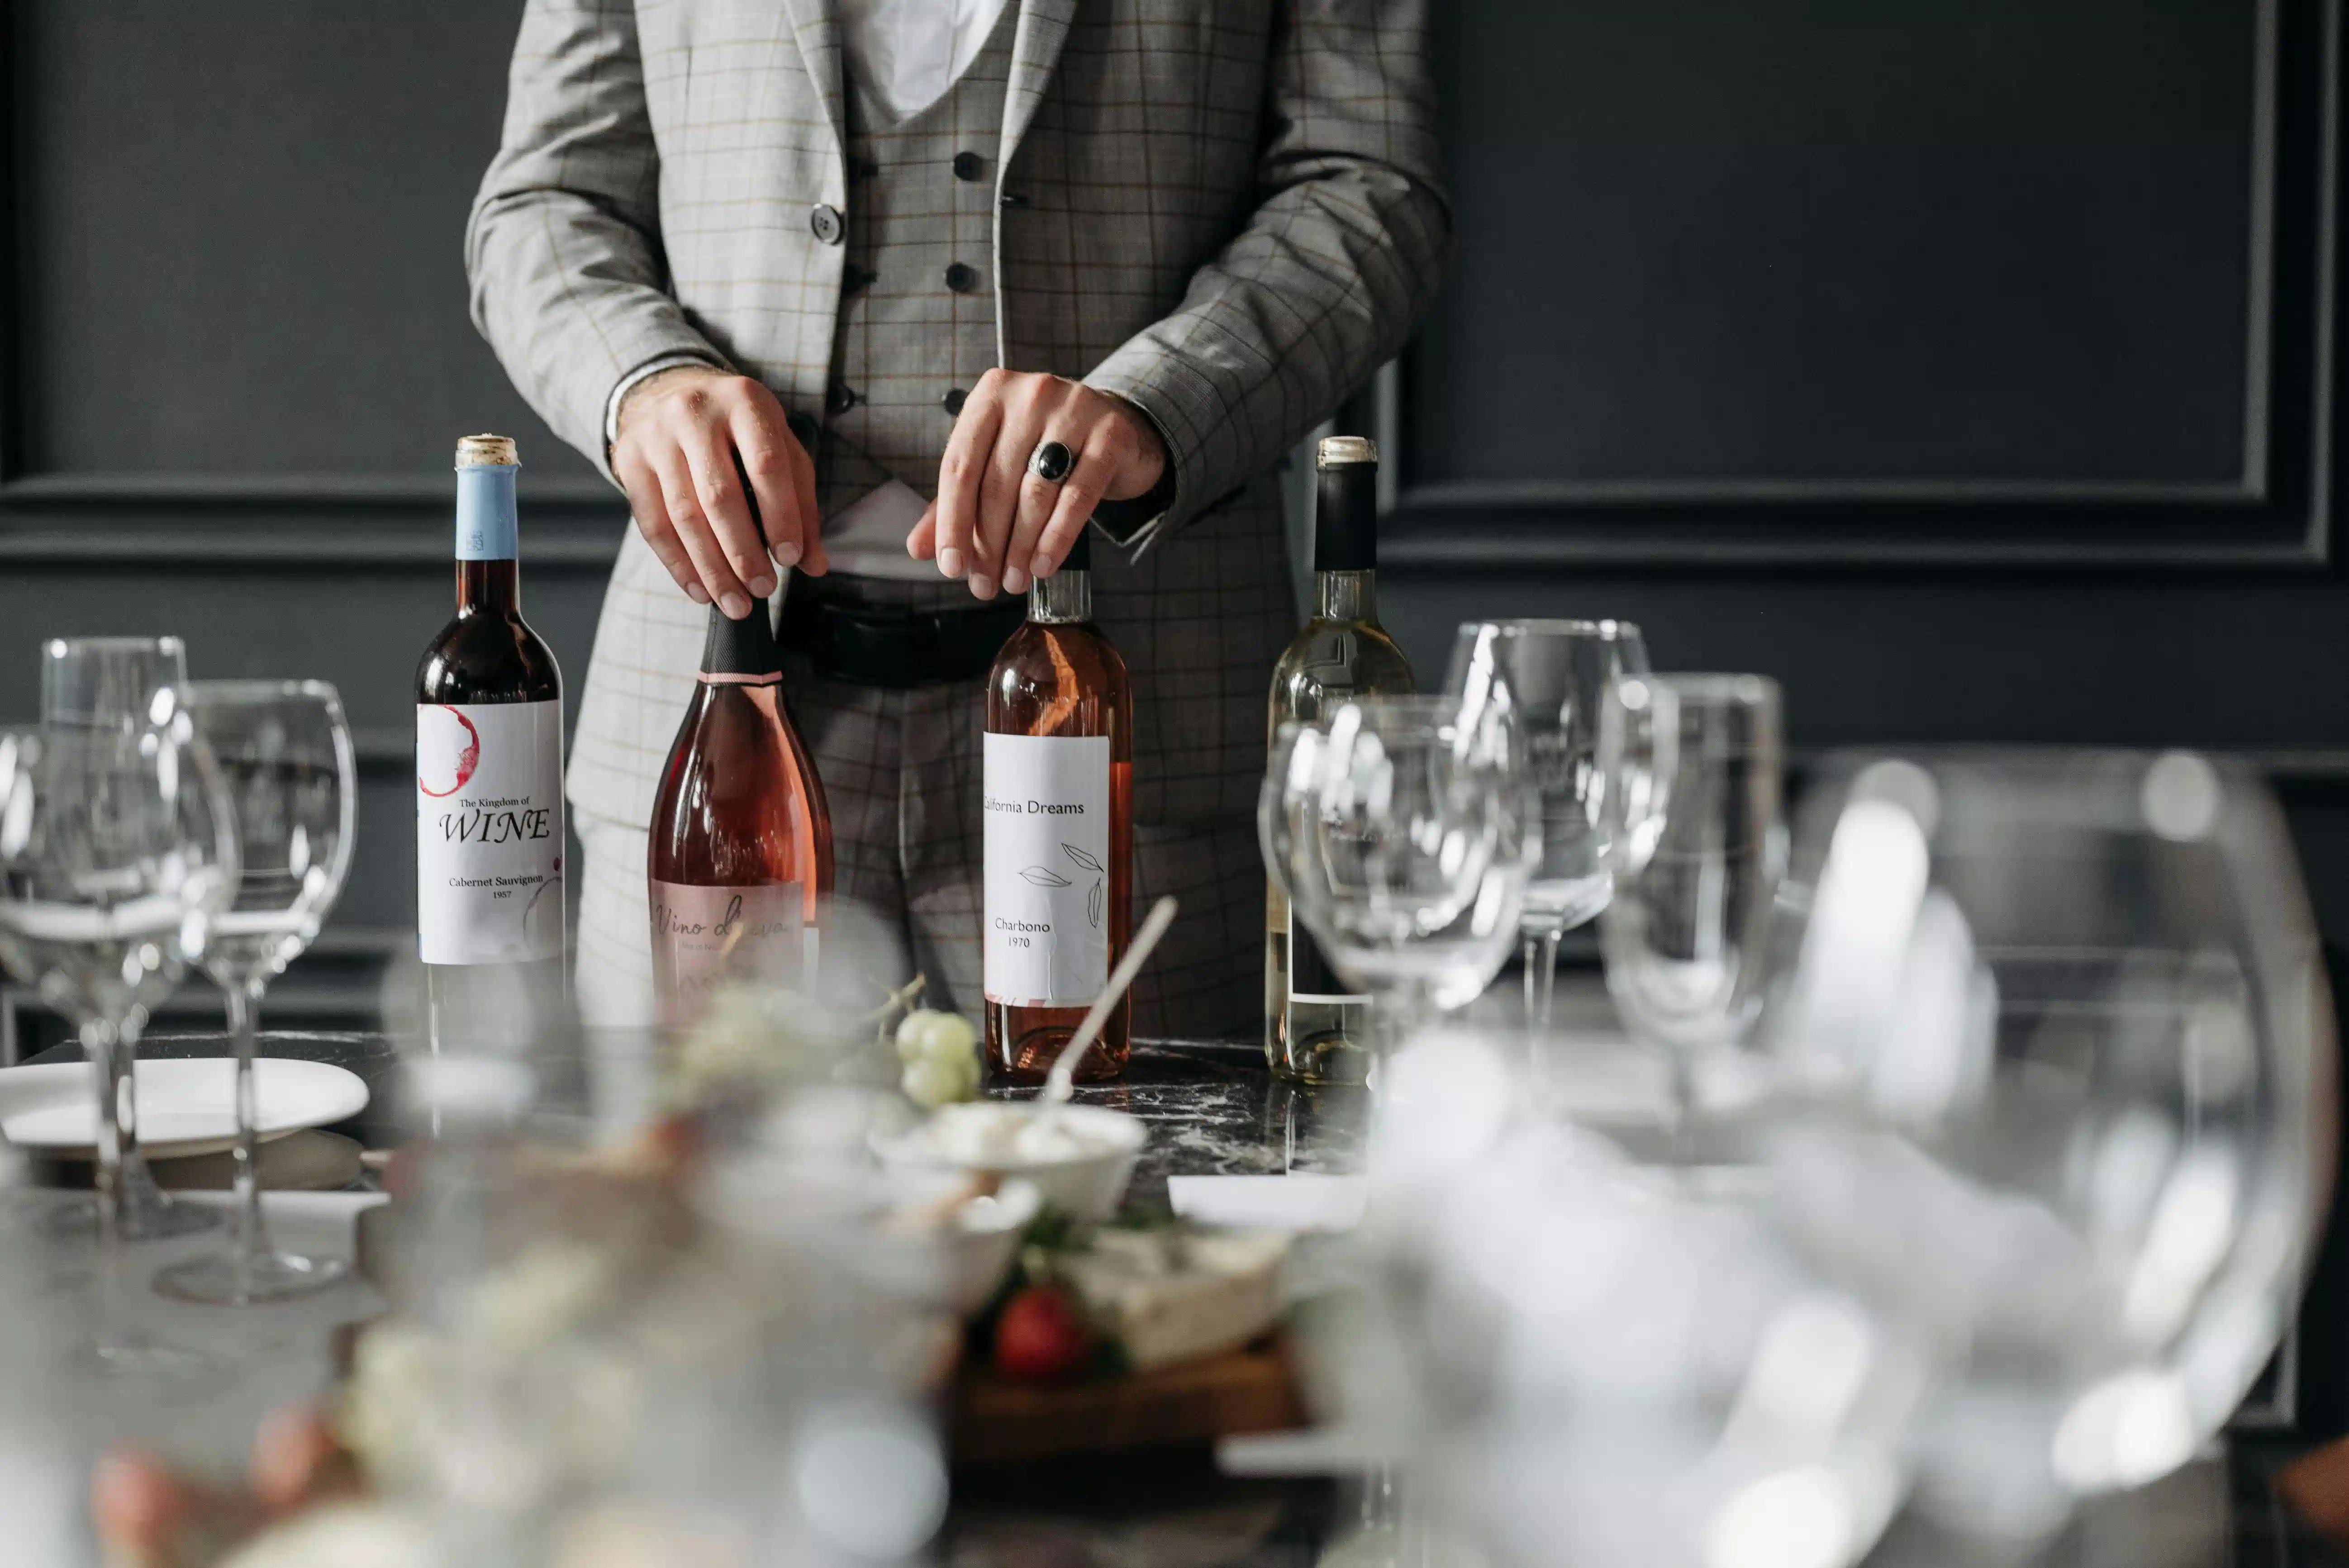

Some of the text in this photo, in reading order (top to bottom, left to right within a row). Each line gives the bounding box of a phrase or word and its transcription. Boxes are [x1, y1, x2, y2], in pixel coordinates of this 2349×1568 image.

[460, 796, 530, 809] The Kingdom of
[1027, 800, 1084, 814] Dreams
[439, 808, 550, 843] WINE
[449, 874, 543, 887] Cabernet Sauvignon
[493, 890, 512, 899] 1957
[656, 904, 707, 936] Vino
[995, 917, 1051, 932] Charbono
[1008, 935, 1030, 948] 1970
